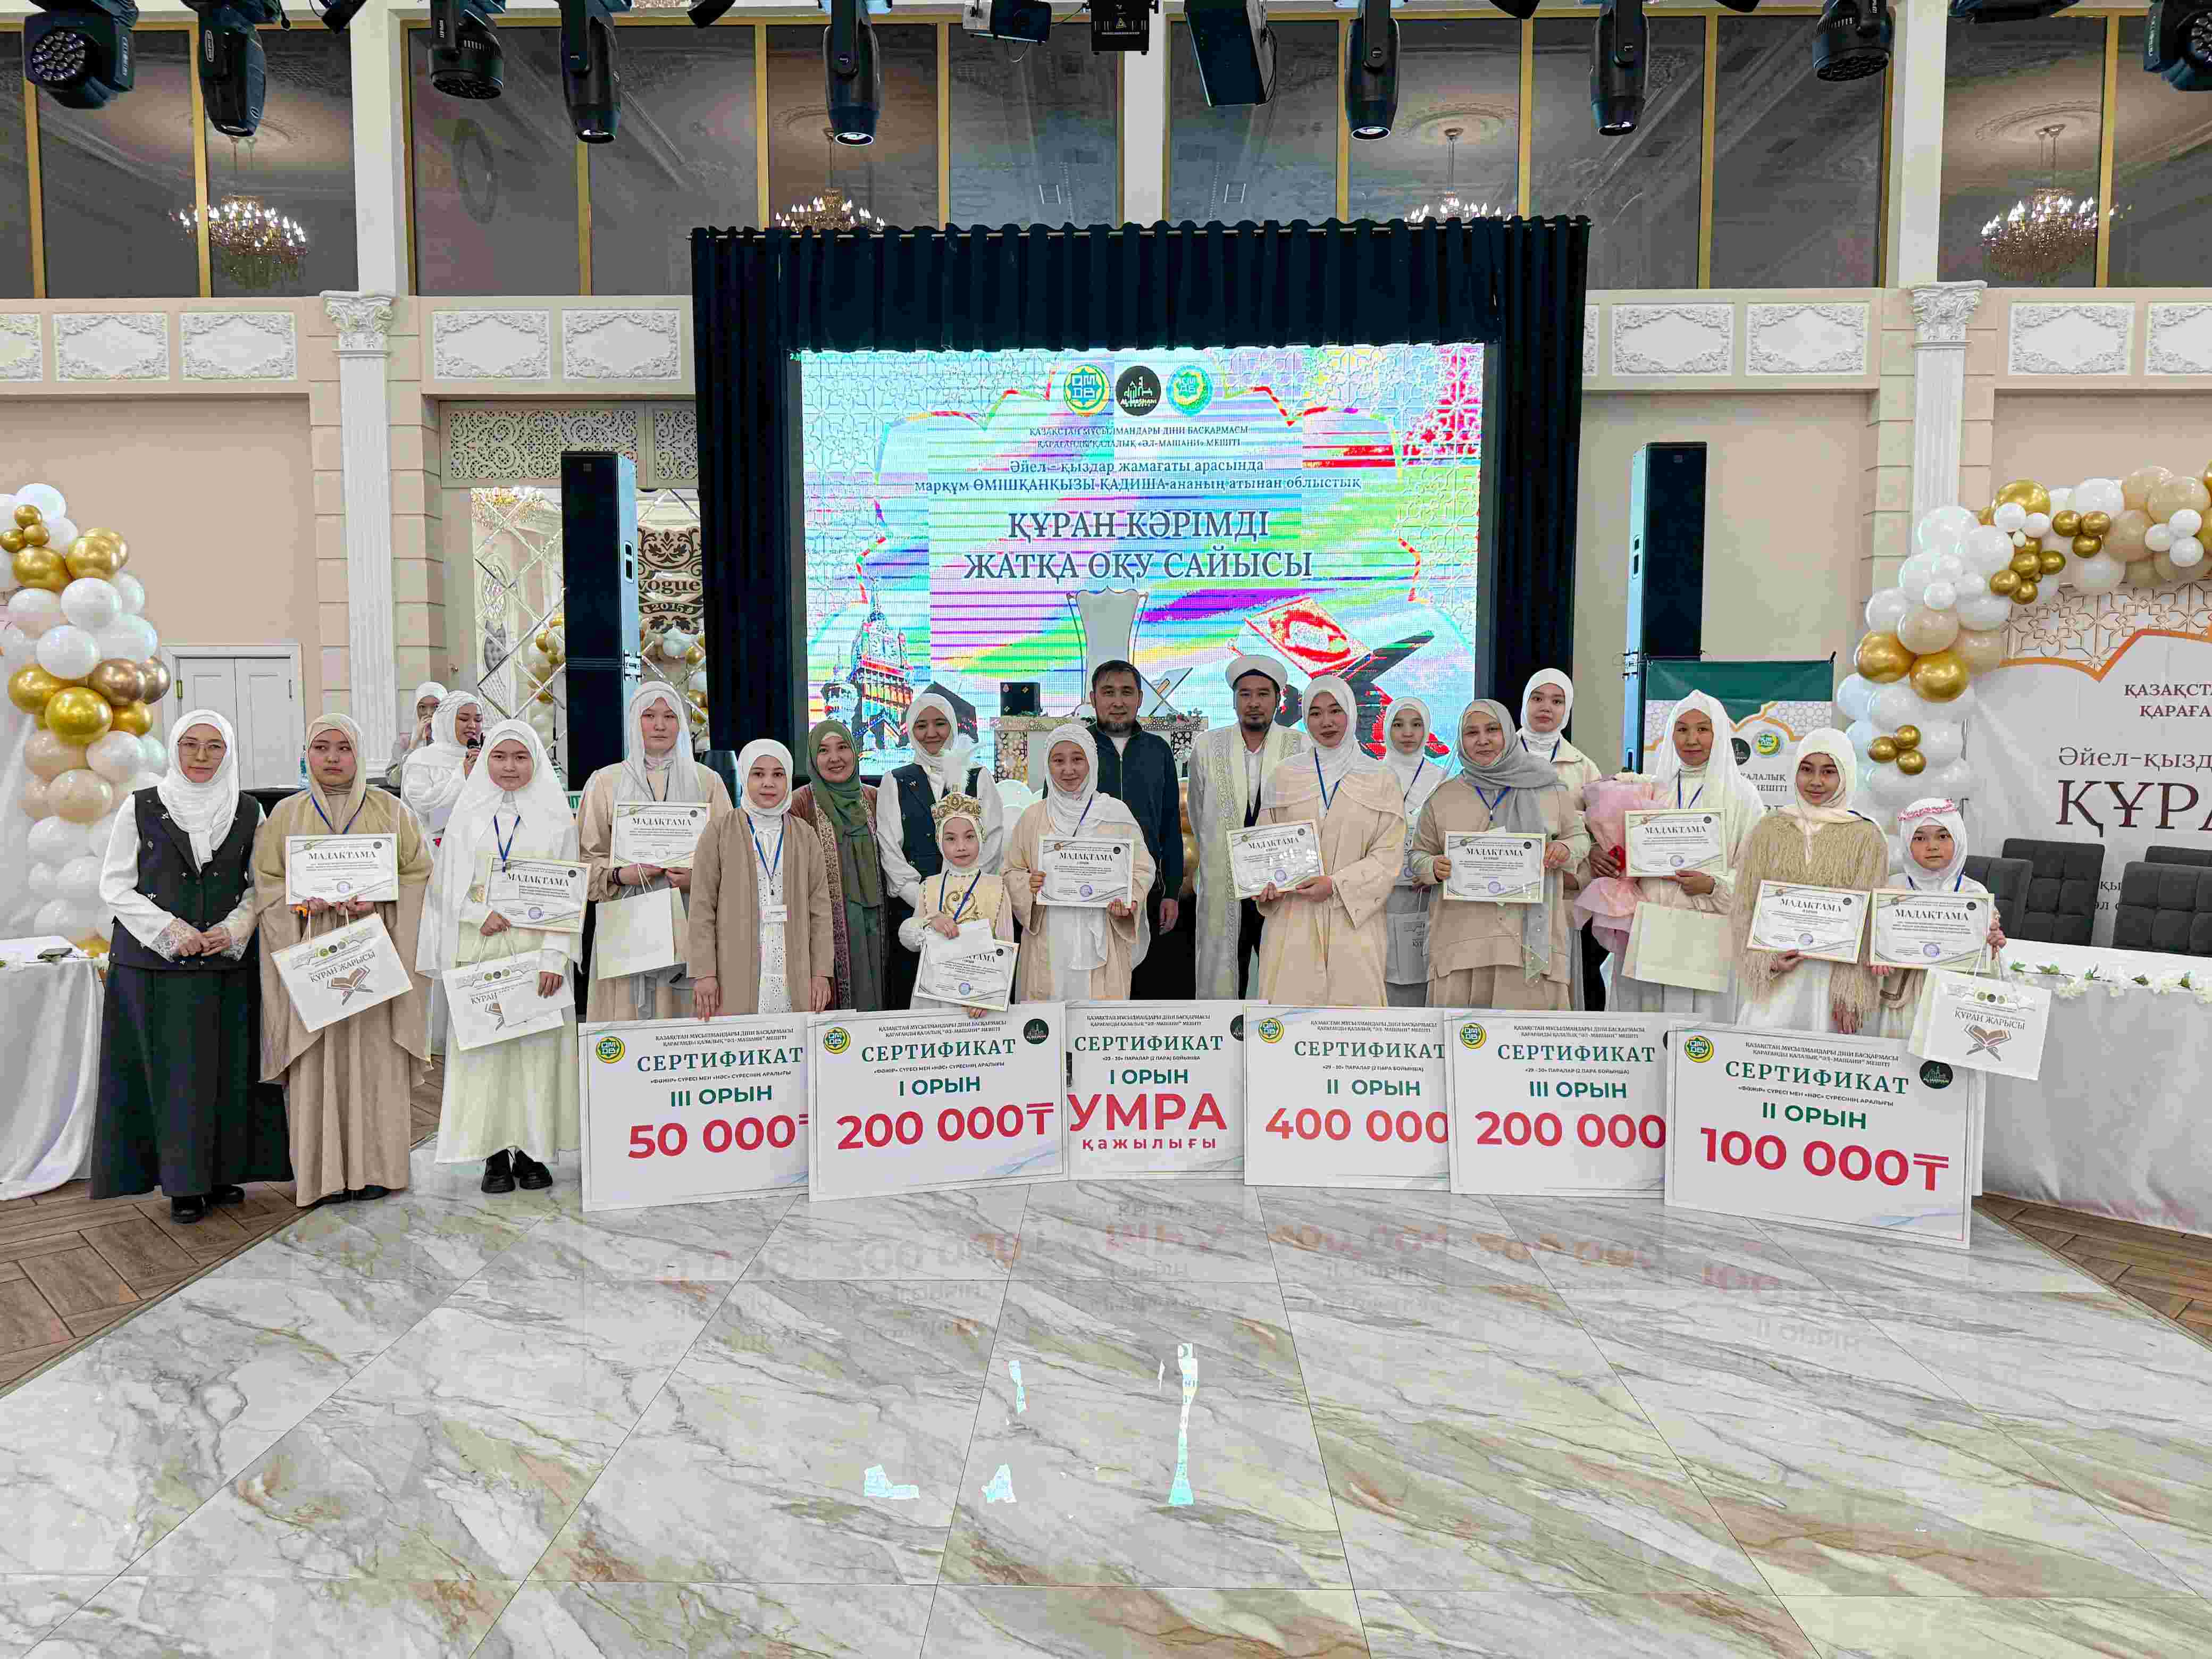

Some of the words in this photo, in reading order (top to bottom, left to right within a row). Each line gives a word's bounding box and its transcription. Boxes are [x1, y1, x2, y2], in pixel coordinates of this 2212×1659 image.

[1010, 461, 1045, 473] Әйел
[1061, 463, 1114, 476] қыздар
[1119, 462, 1191, 473] жамағаты
[1195, 461, 1263, 474] арасында
[1229, 479, 1281, 489] атынан
[1287, 477, 1361, 489] облыстық
[1008, 512, 1116, 543] ҚҰРАН
[1127, 510, 1269, 542] КӘРІМДІ
[965, 553, 1079, 584] ЖАТҚА
[1088, 552, 1152, 583] ОҚУ
[1163, 545, 1312, 578] САЙЫСЫ
[639, 581, 700, 594] vogue
[652, 604, 685, 612] 2015
[2124, 683, 2212, 698] ҚАЗАҚСТ
[1740, 773, 1787, 782] АЛАЛЫҚ
[2056, 780, 2212, 838] ҚҰР
[861, 1038, 1016, 1062] СЕРТИФИКАТ
[1074, 1036, 1223, 1051] СЕРТИФИКАТ
[1294, 1041, 1445, 1059] СЕРТИФИКАТ
[1497, 1044, 1655, 1062] СЕРТИФИКАТ
[637, 1047, 803, 1073] СЕРТИФИКАТ
[911, 1076, 981, 1095] ОРЫН
[1122, 1069, 1189, 1084] ОРЫН
[1725, 1061, 1909, 1094] СЕРТИФИКАТ
[671, 1090, 690, 1107] III
[699, 1085, 773, 1105] ОРЫН
[1327, 1079, 1338, 1094] II
[1352, 1079, 1420, 1096] ОРЫН
[1529, 1081, 1548, 1097] III
[1556, 1082, 1627, 1098] ОРЫН
[1067, 1093, 1228, 1132] УМРА
[1762, 1102, 1775, 1119] II
[1784, 1104, 1866, 1129] ОРЫН
[836, 1110, 924, 1150] 200
[1266, 1108, 1351, 1141] 400
[1474, 1111, 1562, 1147] 200
[628, 1122, 688, 1159] 50
[1083, 1138, 1217, 1151] қажылығы
[1700, 1127, 1787, 1170] 100
